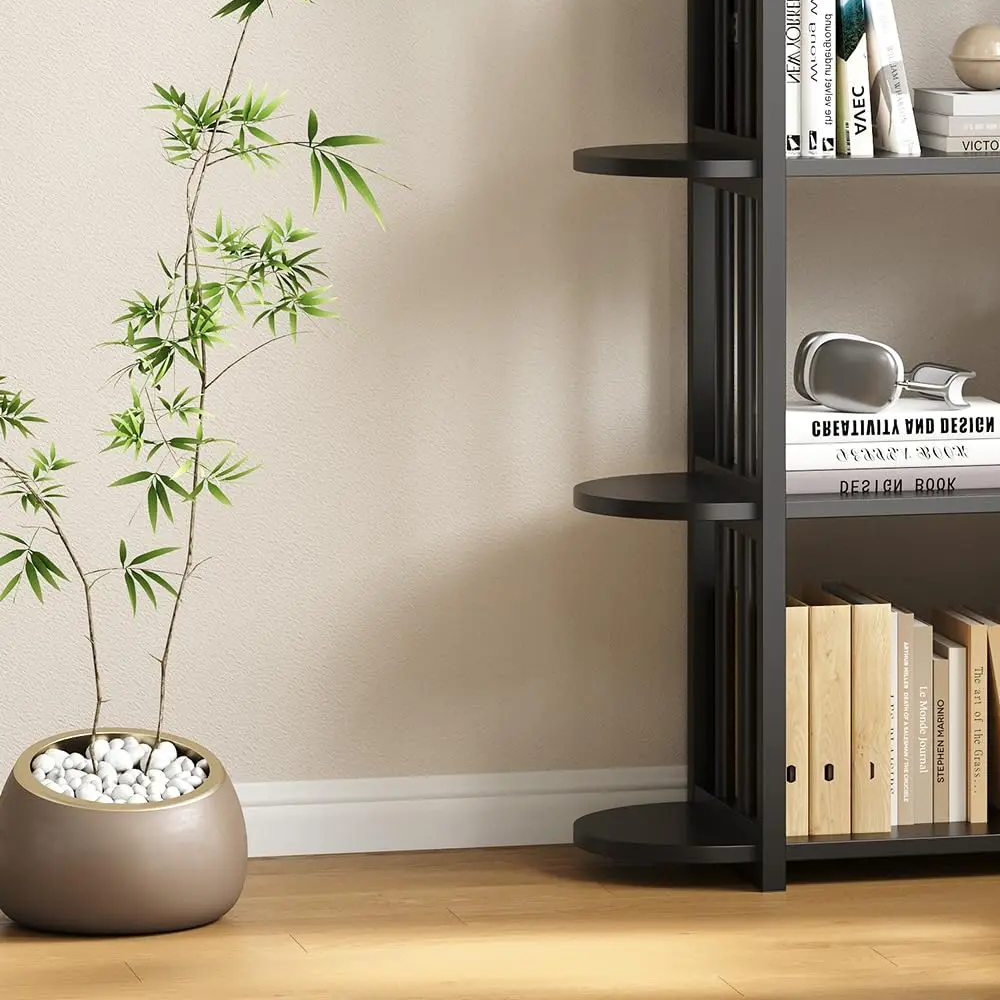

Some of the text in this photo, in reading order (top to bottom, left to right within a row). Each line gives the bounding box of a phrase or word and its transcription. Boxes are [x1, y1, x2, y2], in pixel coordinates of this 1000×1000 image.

[974, 667, 983, 683] The
[974, 691, 982, 704] art
[975, 711, 983, 723] of
[919, 686, 928, 773] Le Monde Journal
[974, 728, 982, 745] the
